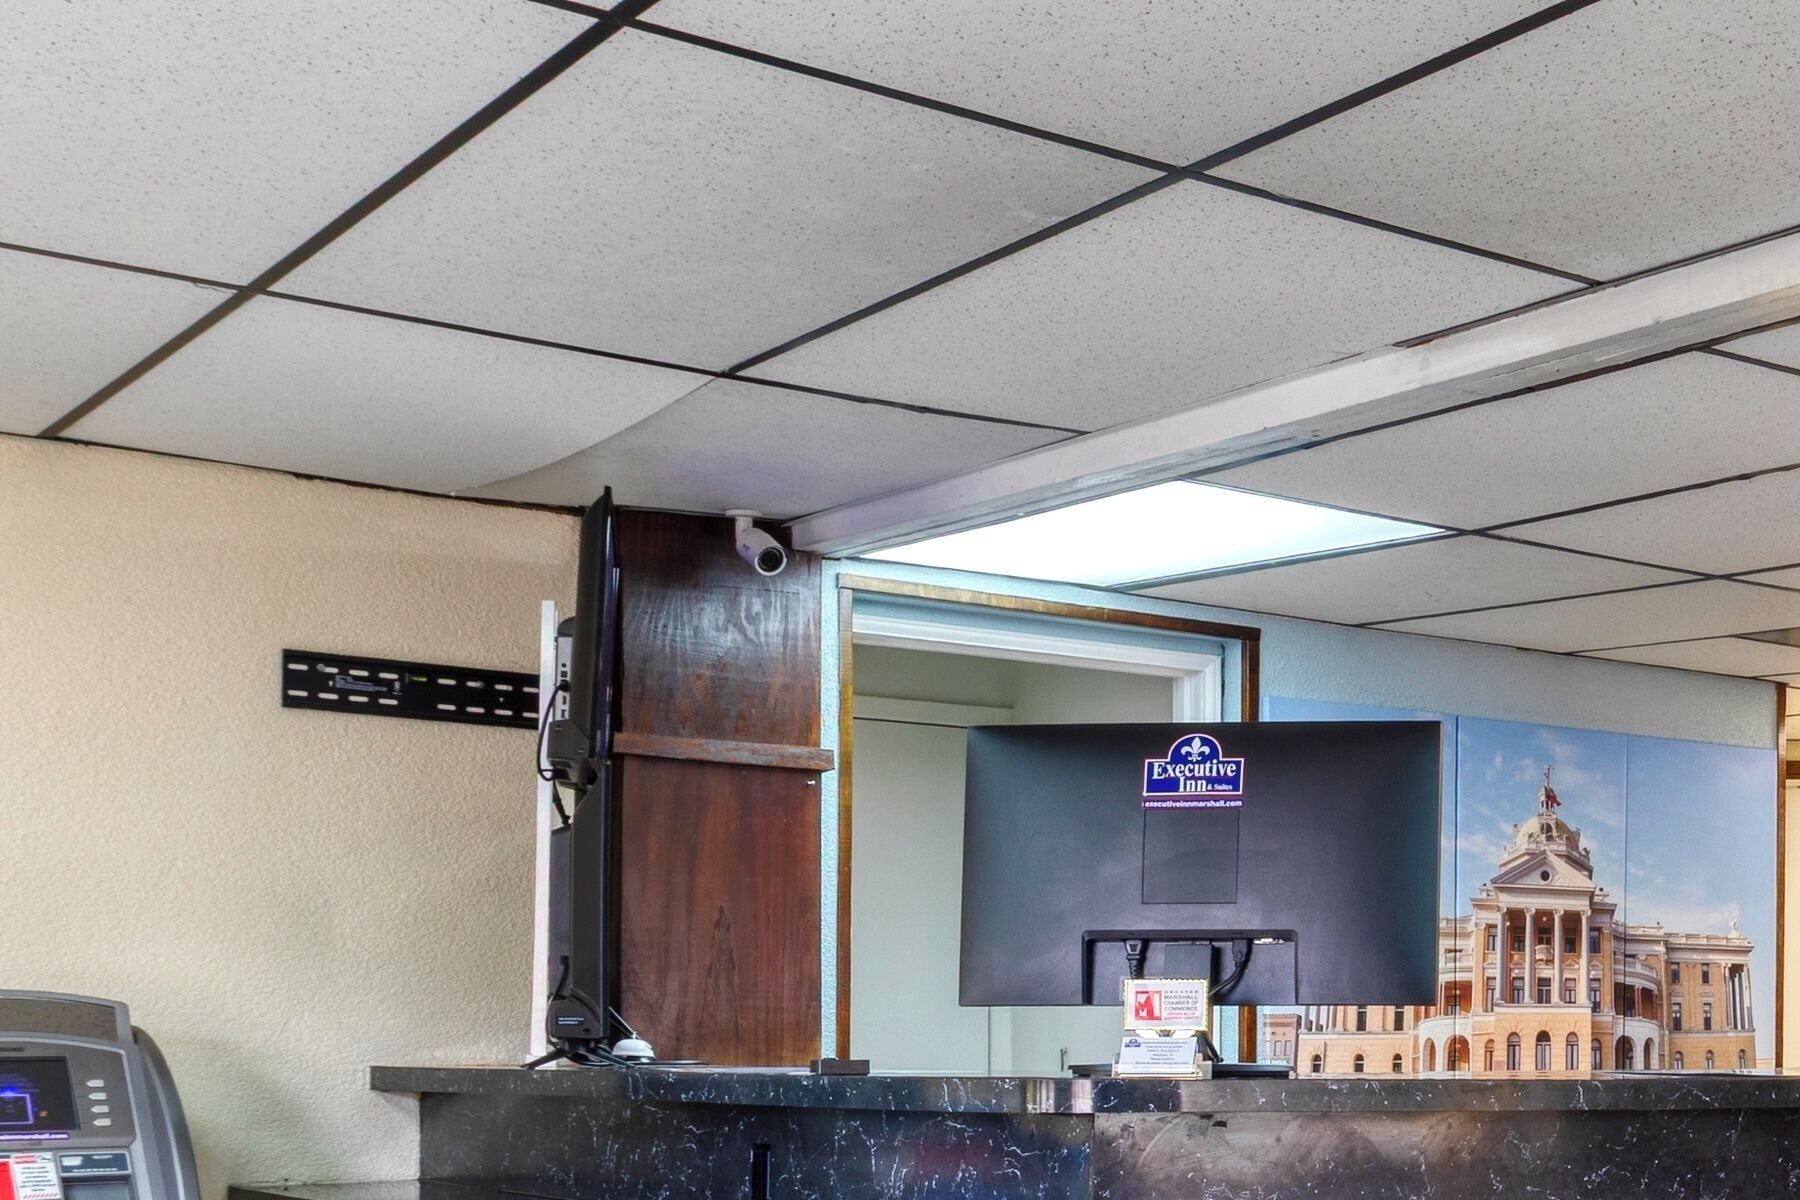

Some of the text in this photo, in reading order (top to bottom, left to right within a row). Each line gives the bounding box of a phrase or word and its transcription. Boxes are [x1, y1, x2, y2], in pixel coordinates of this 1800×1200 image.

[1151, 758, 1237, 780] Executive
[1178, 776, 1233, 793] Inn & Suites
[1145, 799, 1243, 809] executiveinnmarshall.com
